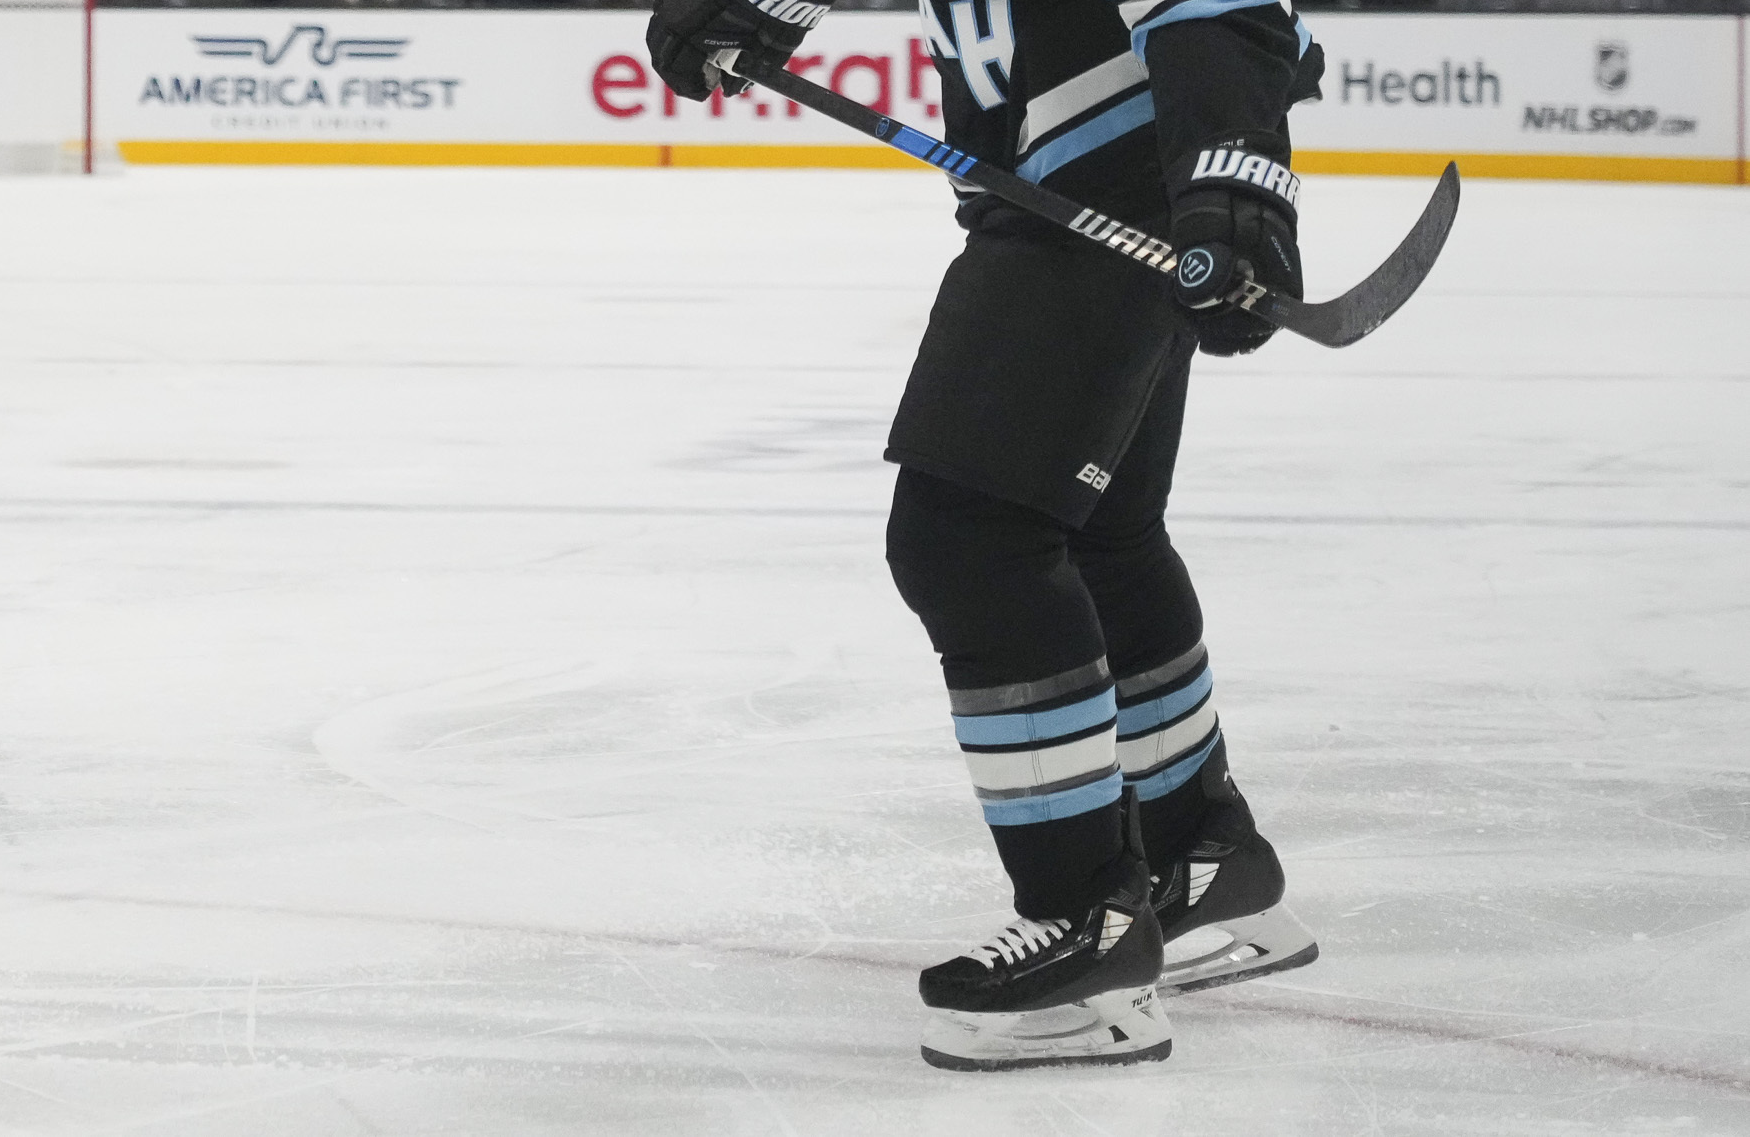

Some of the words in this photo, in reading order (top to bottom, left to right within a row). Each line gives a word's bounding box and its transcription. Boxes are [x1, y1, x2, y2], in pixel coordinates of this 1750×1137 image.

[704, 39, 739, 47] COVERT
[139, 77, 327, 109] AMERICA
[339, 77, 461, 109] FIRST
[1340, 57, 1501, 106] Health
